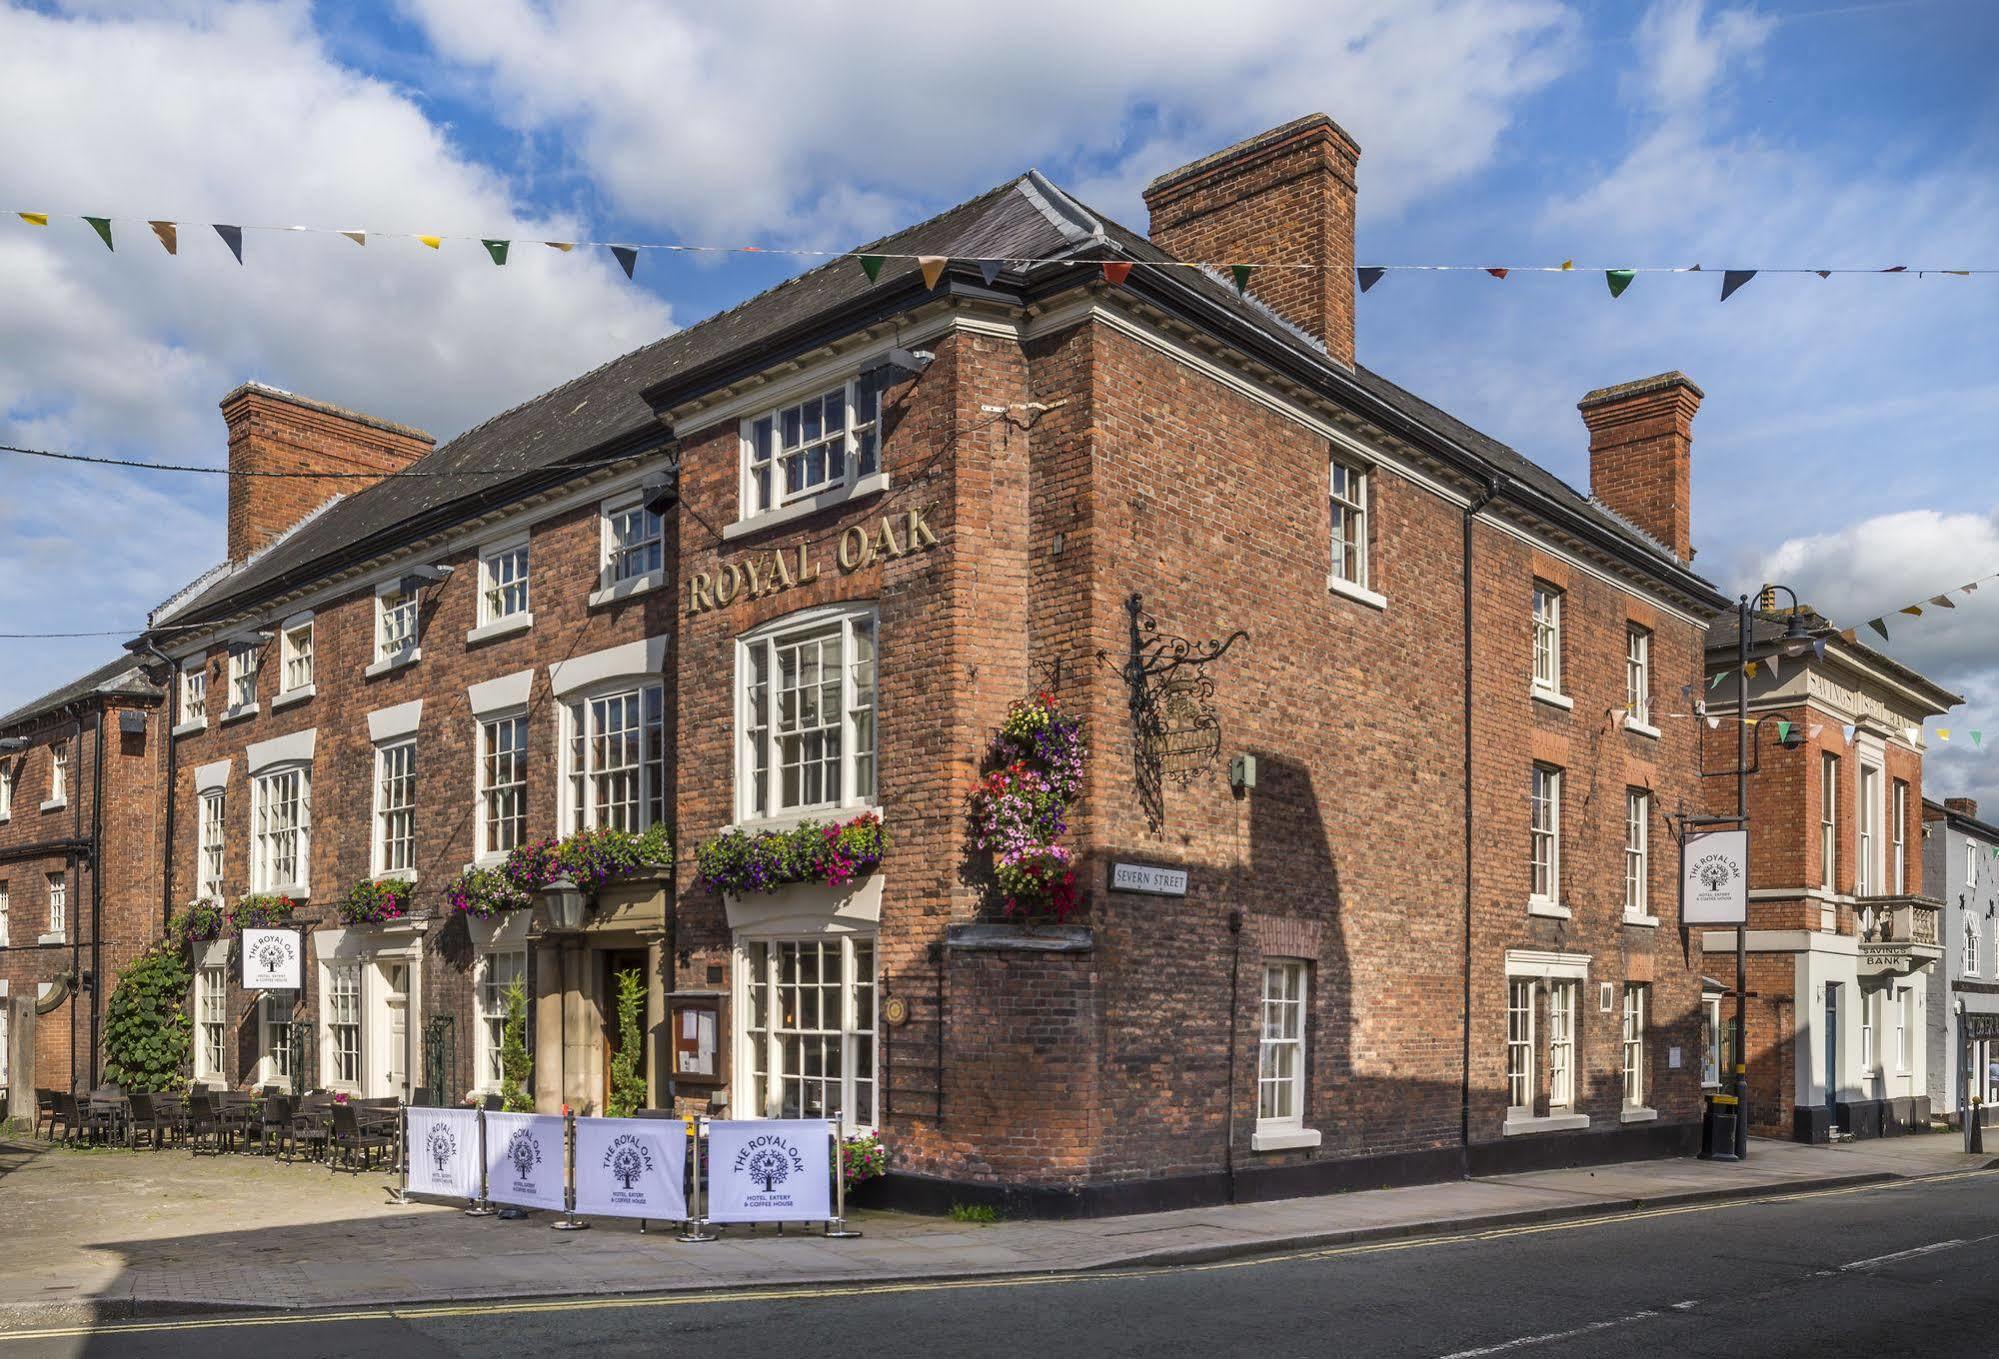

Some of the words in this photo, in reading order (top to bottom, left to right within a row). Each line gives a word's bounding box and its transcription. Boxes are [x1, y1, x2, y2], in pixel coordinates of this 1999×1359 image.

[689, 541, 821, 613] ROYAL
[838, 501, 940, 572] OAK
[1117, 869, 1150, 884] SEVERN
[1154, 874, 1184, 888] STREET
[1690, 863, 1701, 880] THE
[1700, 854, 1728, 864] ROYAL
[1729, 861, 1740, 879] OAK
[249, 943, 260, 959] THE
[258, 935, 284, 945] ROYAL
[284, 943, 295, 960] OAK
[1867, 956, 1900, 965] BANK
[507, 1138, 515, 1160] THE
[513, 1128, 533, 1142] ROYAL
[533, 1140, 542, 1164] OAK
[603, 1146, 615, 1169] THE
[614, 1133, 640, 1148] ROYAL
[640, 1146, 653, 1171] OAK
[734, 1148, 750, 1173] THE
[748, 1135, 787, 1150] ROYAL
[788, 1147, 804, 1172] OAK
